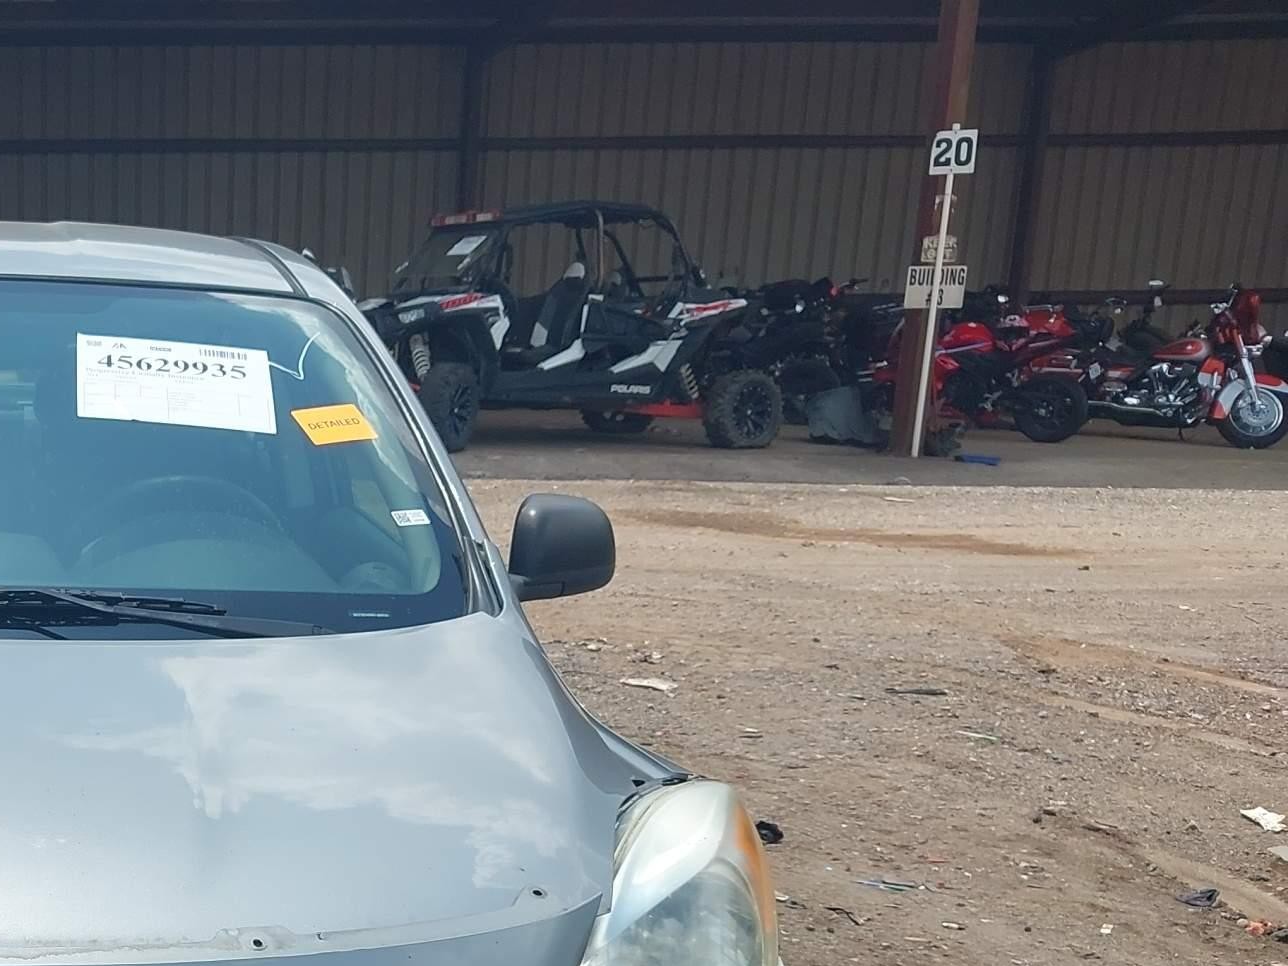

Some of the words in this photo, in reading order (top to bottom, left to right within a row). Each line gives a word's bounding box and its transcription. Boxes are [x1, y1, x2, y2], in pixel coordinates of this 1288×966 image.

[933, 136, 973, 167] 20
[926, 248, 953, 259] OT
[97, 354, 247, 380] 45629935
[308, 417, 360, 430] DETAILED
